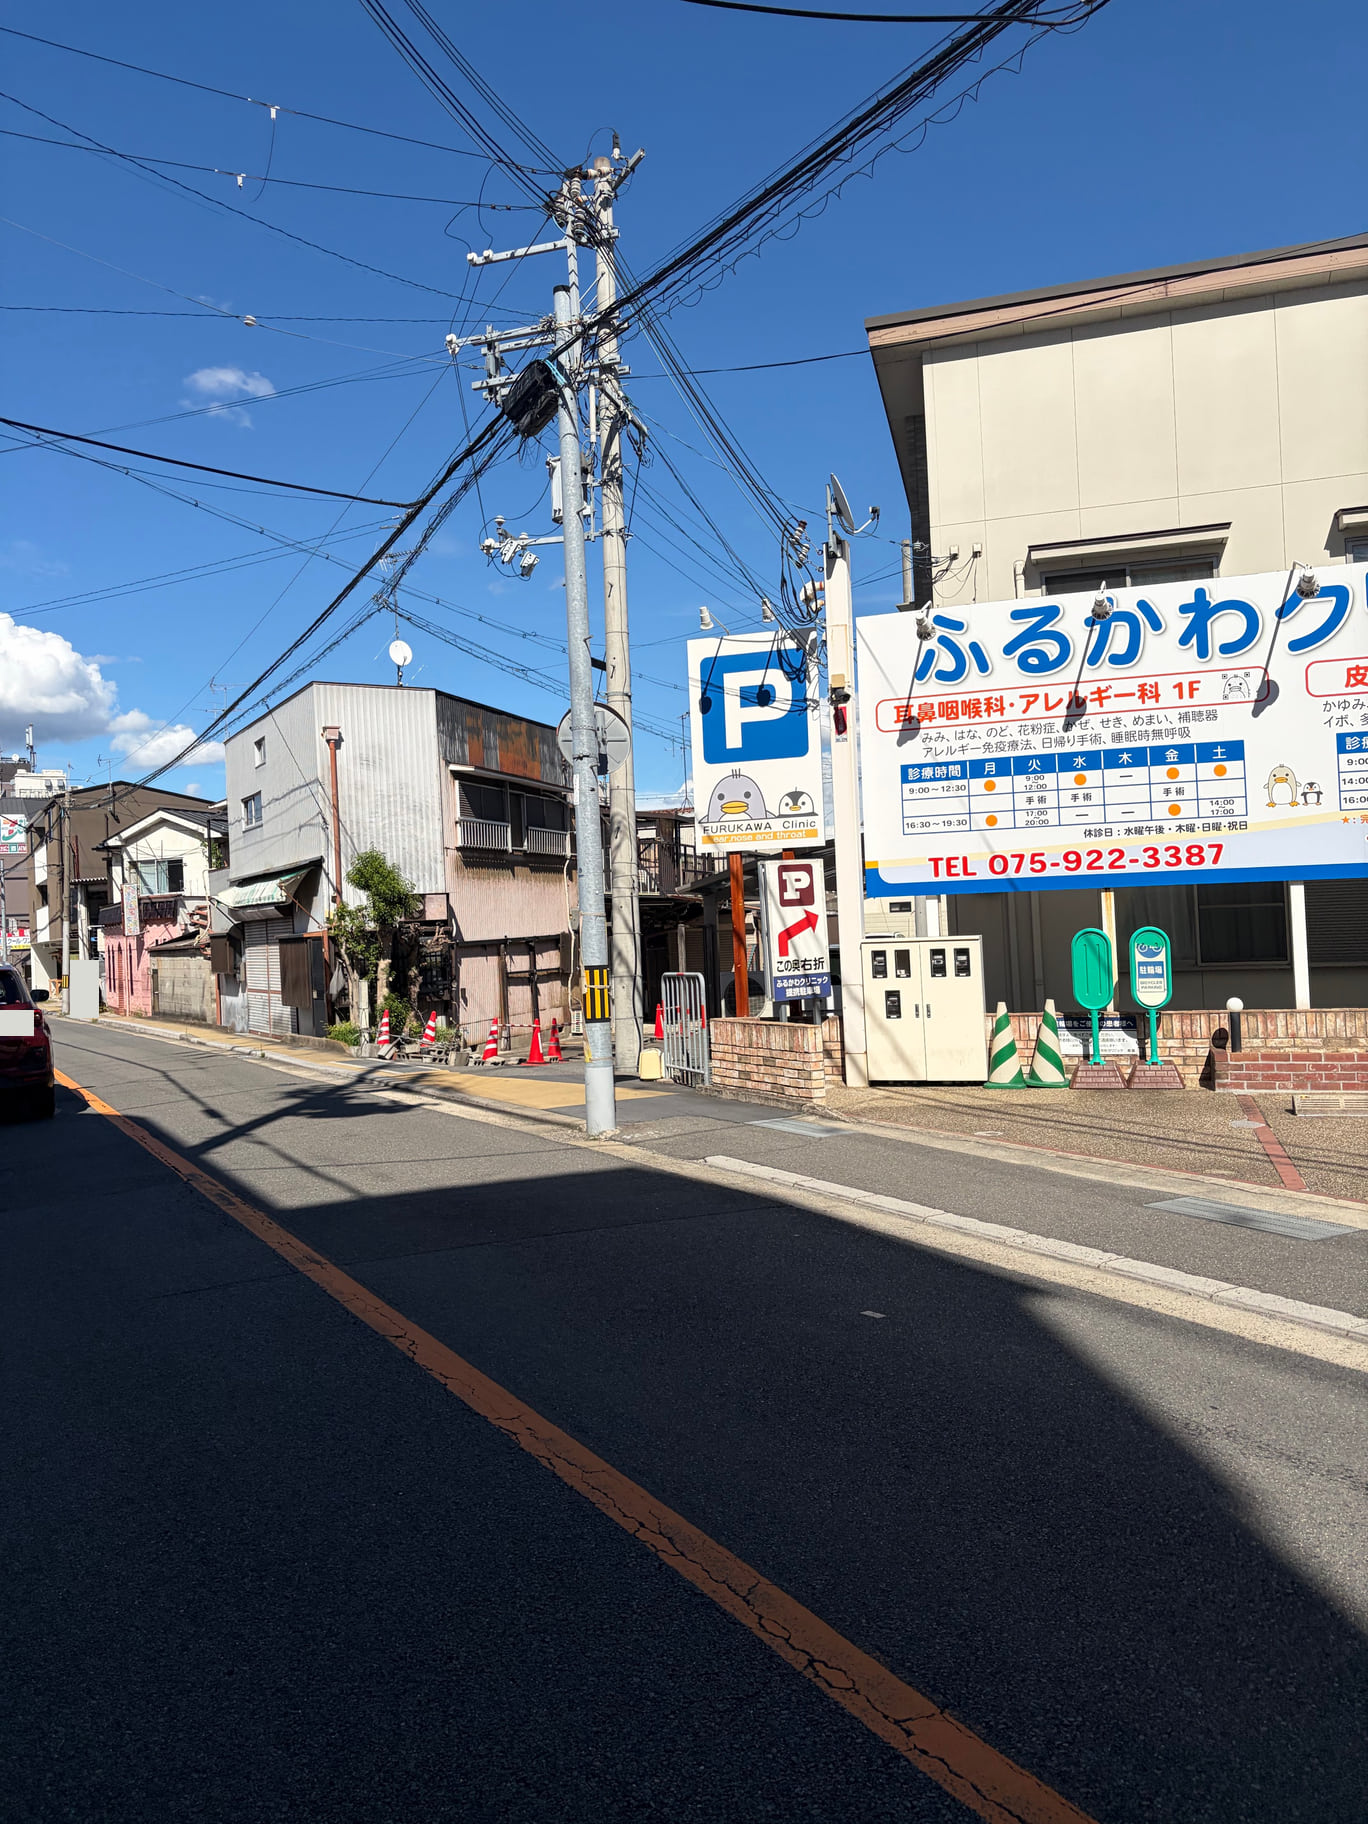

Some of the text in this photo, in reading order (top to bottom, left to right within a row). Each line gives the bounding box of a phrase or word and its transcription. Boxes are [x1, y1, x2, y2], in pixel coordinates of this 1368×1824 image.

[914, 570, 1368, 683] ふるかわク
[723, 667, 793, 750] P
[893, 680, 1201, 725] 耳鼻咽喉科・アレルギー科 1F
[907, 745, 1228, 781] 診療時間 月 火 水 木 金 土
[1025, 774, 1045, 782] 9:00
[1023, 783, 1048, 791] 12:00
[1209, 798, 1235, 807] 14:00
[1026, 809, 1048, 817] 17:00
[1210, 808, 1235, 816] 17:00
[703, 818, 816, 835] FURUKAWA Clinic
[1024, 818, 1050, 827] 20:00
[755, 831, 774, 841] and
[776, 829, 807, 839] throat
[928, 843, 1224, 878] TEL 075-922-3387
[782, 871, 812, 900] P
[776, 956, 825, 973] この奥右折
[776, 975, 829, 988] ふるかわクリニック
